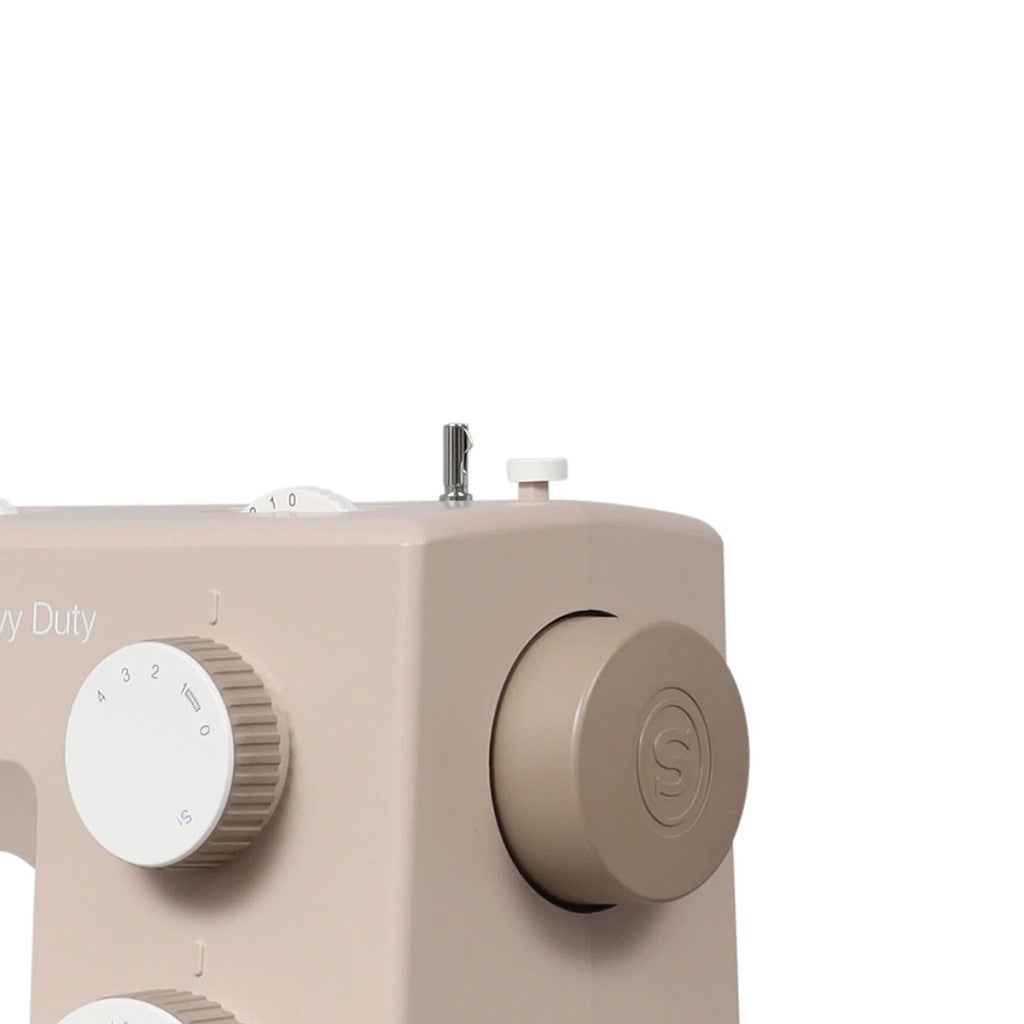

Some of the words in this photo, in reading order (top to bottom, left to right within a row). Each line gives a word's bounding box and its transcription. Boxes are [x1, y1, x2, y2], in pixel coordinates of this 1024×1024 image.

[269, 496, 276, 510] 1
[288, 493, 296, 507] 0
[32, 600, 97, 644] Duty
[97, 690, 106, 702] 4
[121, 667, 131, 682] 3
[151, 664, 160, 679] 2
